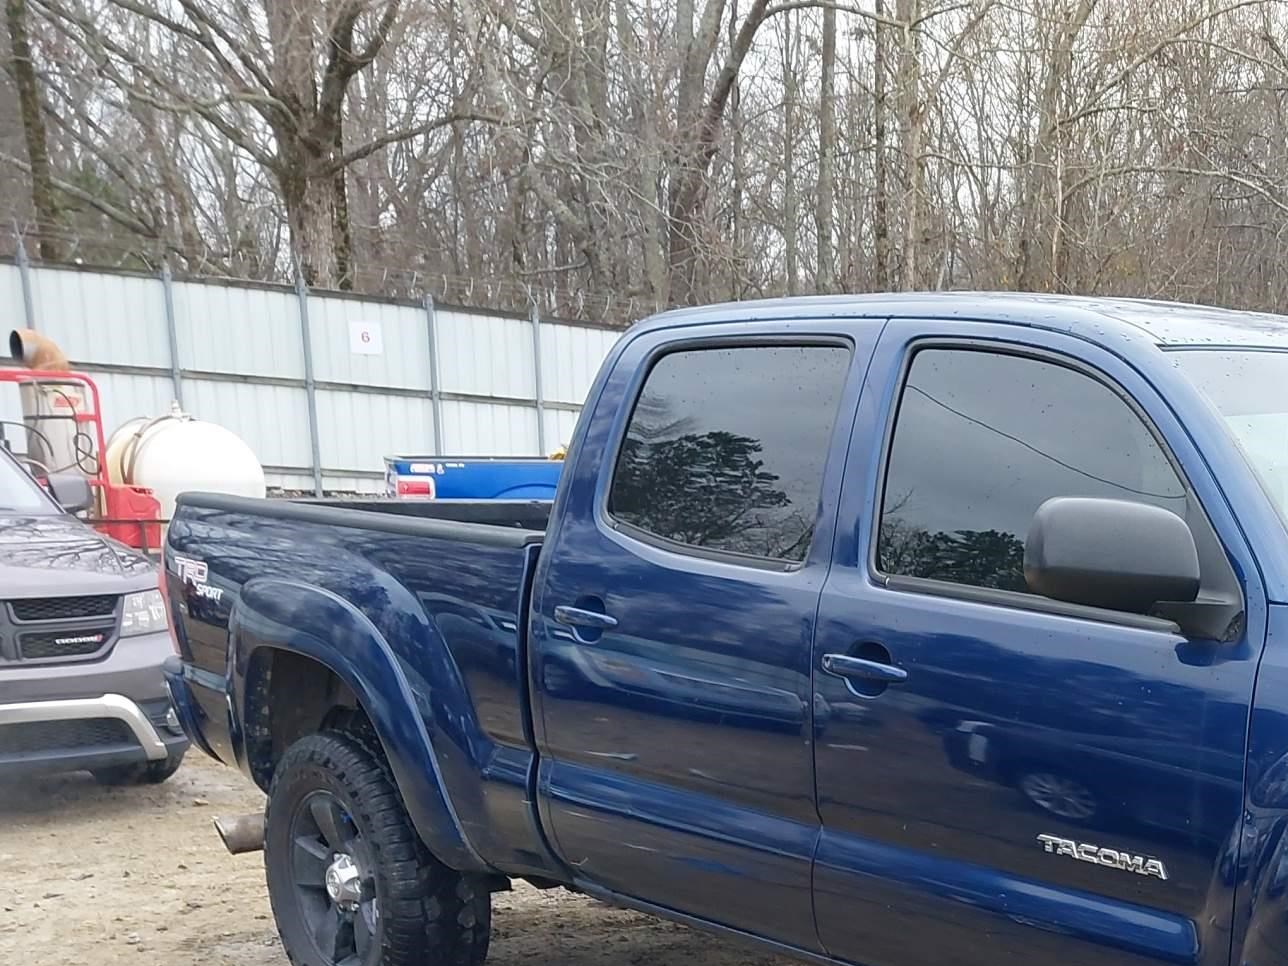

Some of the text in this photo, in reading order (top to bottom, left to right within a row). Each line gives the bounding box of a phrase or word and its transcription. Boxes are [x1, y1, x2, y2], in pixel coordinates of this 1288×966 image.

[361, 331, 371, 343] 6
[173, 556, 209, 586] TRD
[195, 584, 224, 601] SPORT
[1036, 833, 1169, 880] TACOMA
